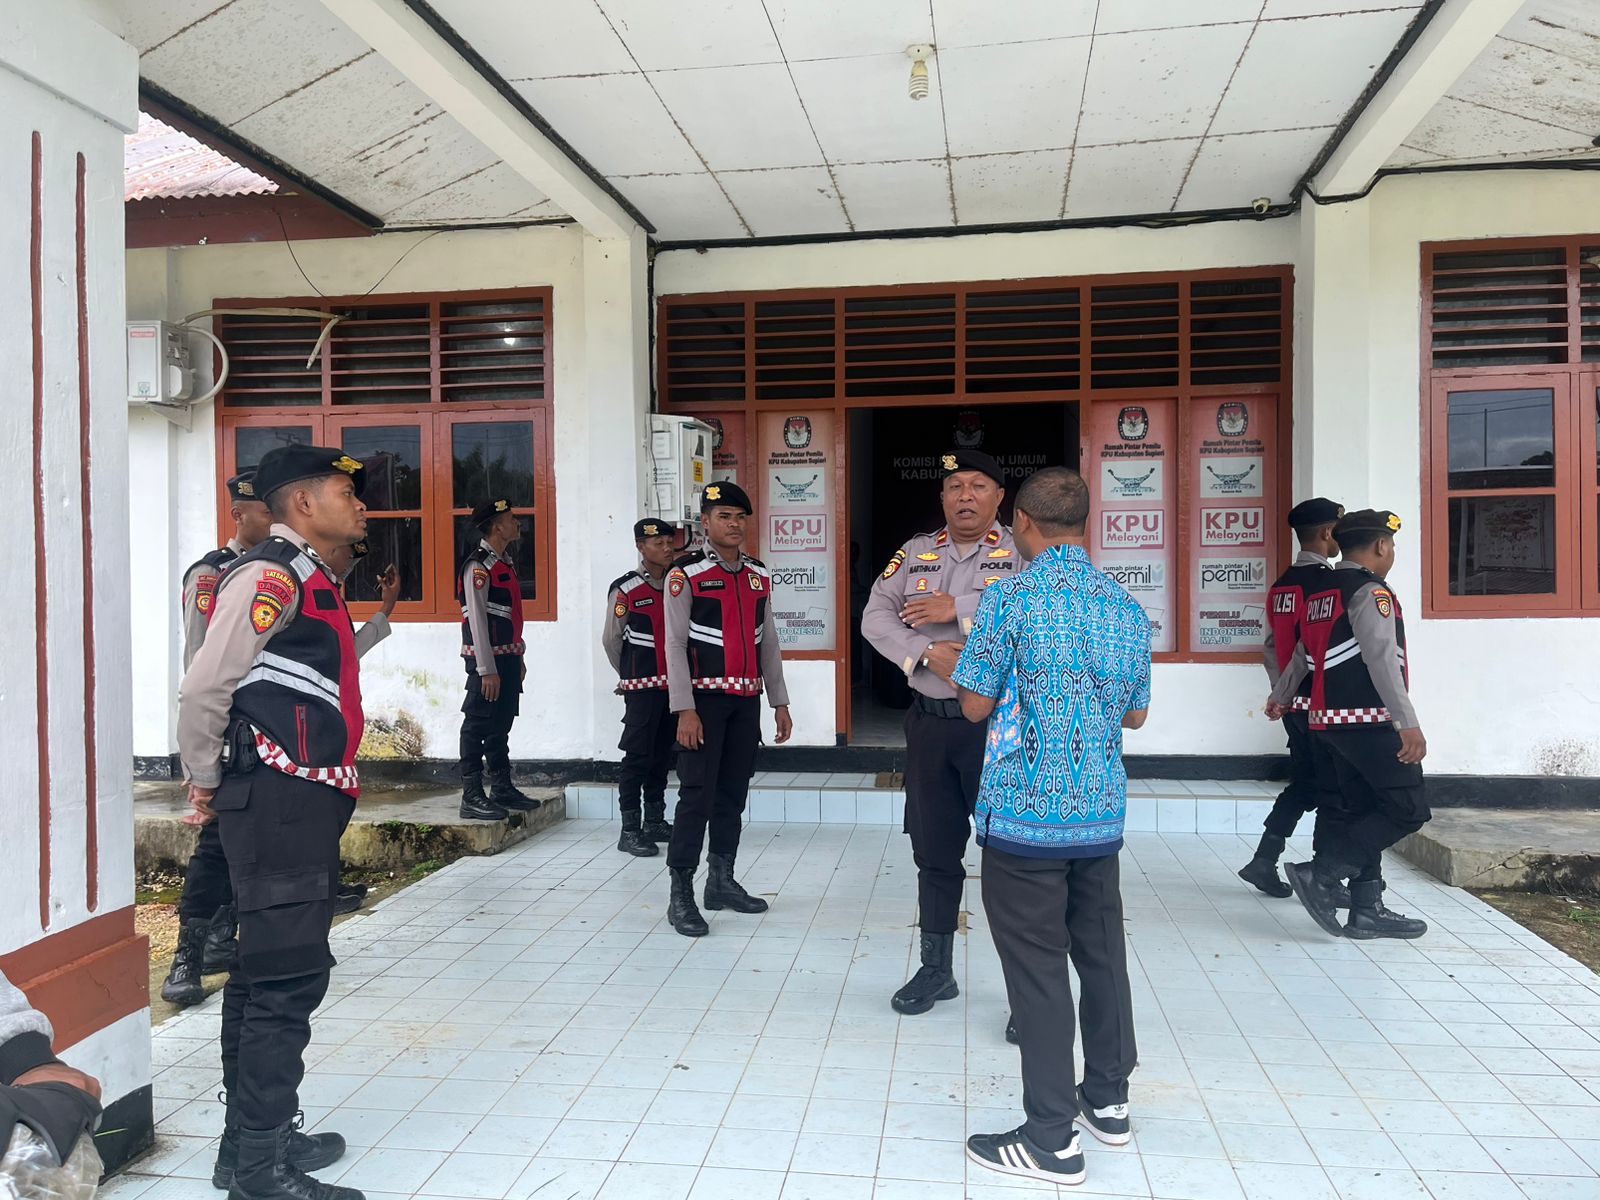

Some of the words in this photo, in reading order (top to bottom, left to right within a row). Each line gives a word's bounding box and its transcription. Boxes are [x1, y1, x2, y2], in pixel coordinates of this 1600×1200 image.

[894, 456, 935, 468] KOMISI
[1008, 454, 1047, 466] UMUM
[1106, 514, 1159, 532] KPU
[1206, 512, 1259, 530] KPU
[774, 519, 822, 536] KPU
[1106, 532, 1158, 544] Melayani
[1206, 530, 1258, 541] Melayani
[774, 536, 822, 546] Melayani
[980, 562, 1012, 570] POLRI
[1224, 562, 1243, 570] pintar
[1306, 596, 1334, 622] POLISI
[1200, 611, 1241, 619] PEMILU
[1200, 628, 1261, 636] INDONESIA
[778, 636, 798, 644] AJU
[1200, 636, 1232, 644] MAJU
